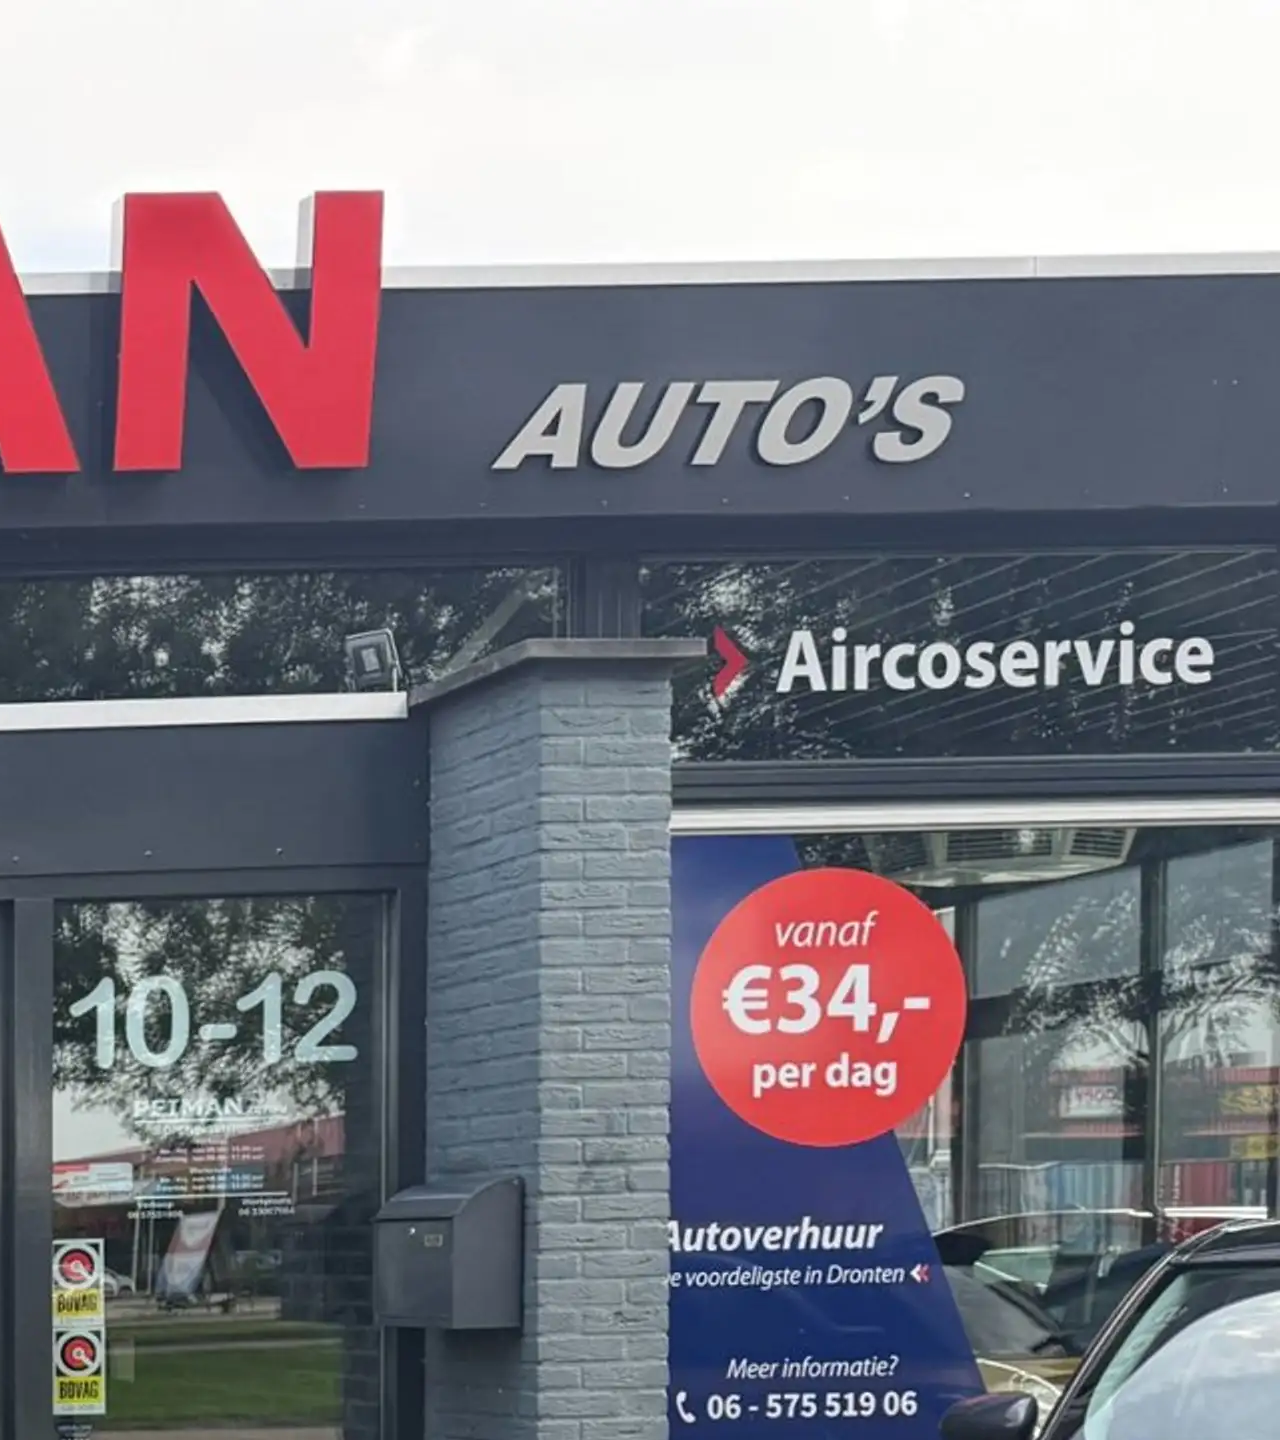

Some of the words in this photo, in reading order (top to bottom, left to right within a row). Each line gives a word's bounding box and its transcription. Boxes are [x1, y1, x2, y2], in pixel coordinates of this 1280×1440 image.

[491, 374, 966, 471] AUTO'S
[776, 620, 1215, 694] Aircoservice
[774, 910, 879, 949] vanaf
[69, 970, 359, 1069] 10-12
[721, 963, 931, 1044] €34,-
[752, 1062, 817, 1097] per
[825, 1052, 899, 1096] dag
[133, 1097, 242, 1117] PEIMAN
[685, 1266, 802, 1292] voordeligste
[804, 1266, 823, 1284] in
[826, 1264, 905, 1284] Dronten
[57, 1293, 98, 1313] BOVAG
[726, 1358, 779, 1379] Meer
[782, 1355, 899, 1379] informatie?
[59, 1380, 100, 1400] BOVAG
[707, 1394, 742, 1420] 06
[766, 1393, 817, 1418] 575
[825, 1391, 876, 1417] 519
[883, 1390, 918, 1416] 06
